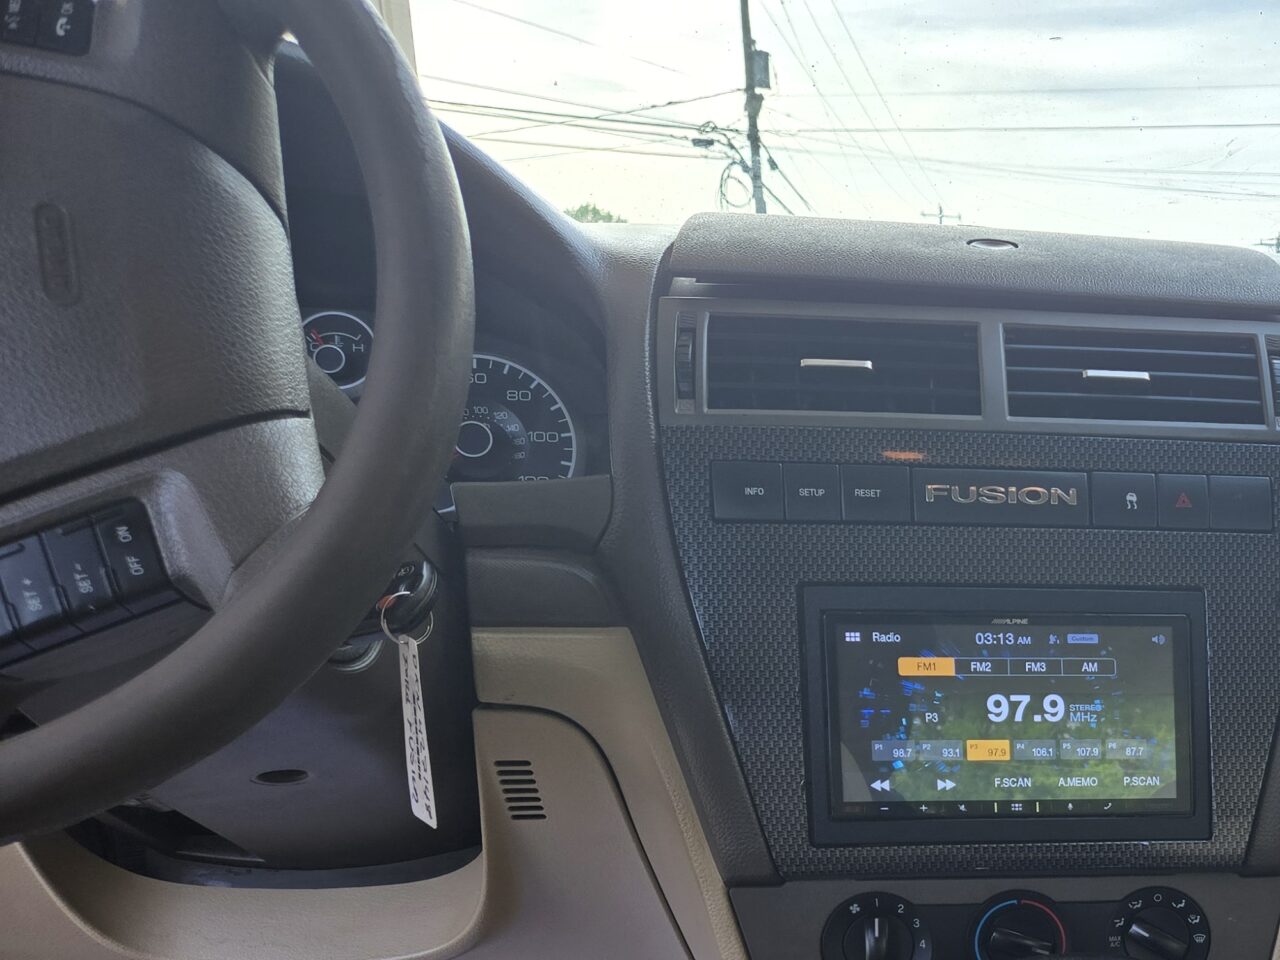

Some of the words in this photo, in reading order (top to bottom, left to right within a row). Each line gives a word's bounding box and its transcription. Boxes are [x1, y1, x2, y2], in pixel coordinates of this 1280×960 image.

[353, 343, 364, 353] H
[506, 390, 532, 401] 80
[473, 406, 489, 414] 100
[493, 411, 508, 420] 120
[527, 431, 559, 442] 100
[744, 487, 765, 496] INFO
[799, 488, 825, 497] SETUP
[854, 489, 881, 498] RESET
[925, 484, 1077, 505] FUSION
[115, 526, 133, 543] ON
[125, 556, 145, 576] OFF
[73, 573, 94, 594] SET
[872, 632, 901, 642] Radio
[975, 632, 1014, 645] 03:13
[1017, 636, 1032, 645] AM
[917, 662, 936, 671] FM1
[970, 662, 992, 672] FM2
[1025, 662, 1047, 672] FM3
[1081, 662, 1098, 672] AM
[986, 693, 1065, 723] 97.9
[925, 712, 939, 723] P3
[1069, 712, 1097, 722] MHz
[922, 743, 931, 751] P2
[987, 748, 1006, 757] 97.9
[994, 778, 1031, 788] F.SCAN
[1058, 777, 1098, 787] A.MEMO
[1123, 776, 1160, 786] P.SCAN
[897, 904, 905, 914] 2
[913, 918, 920, 928] 3
[919, 939, 926, 949] 4
